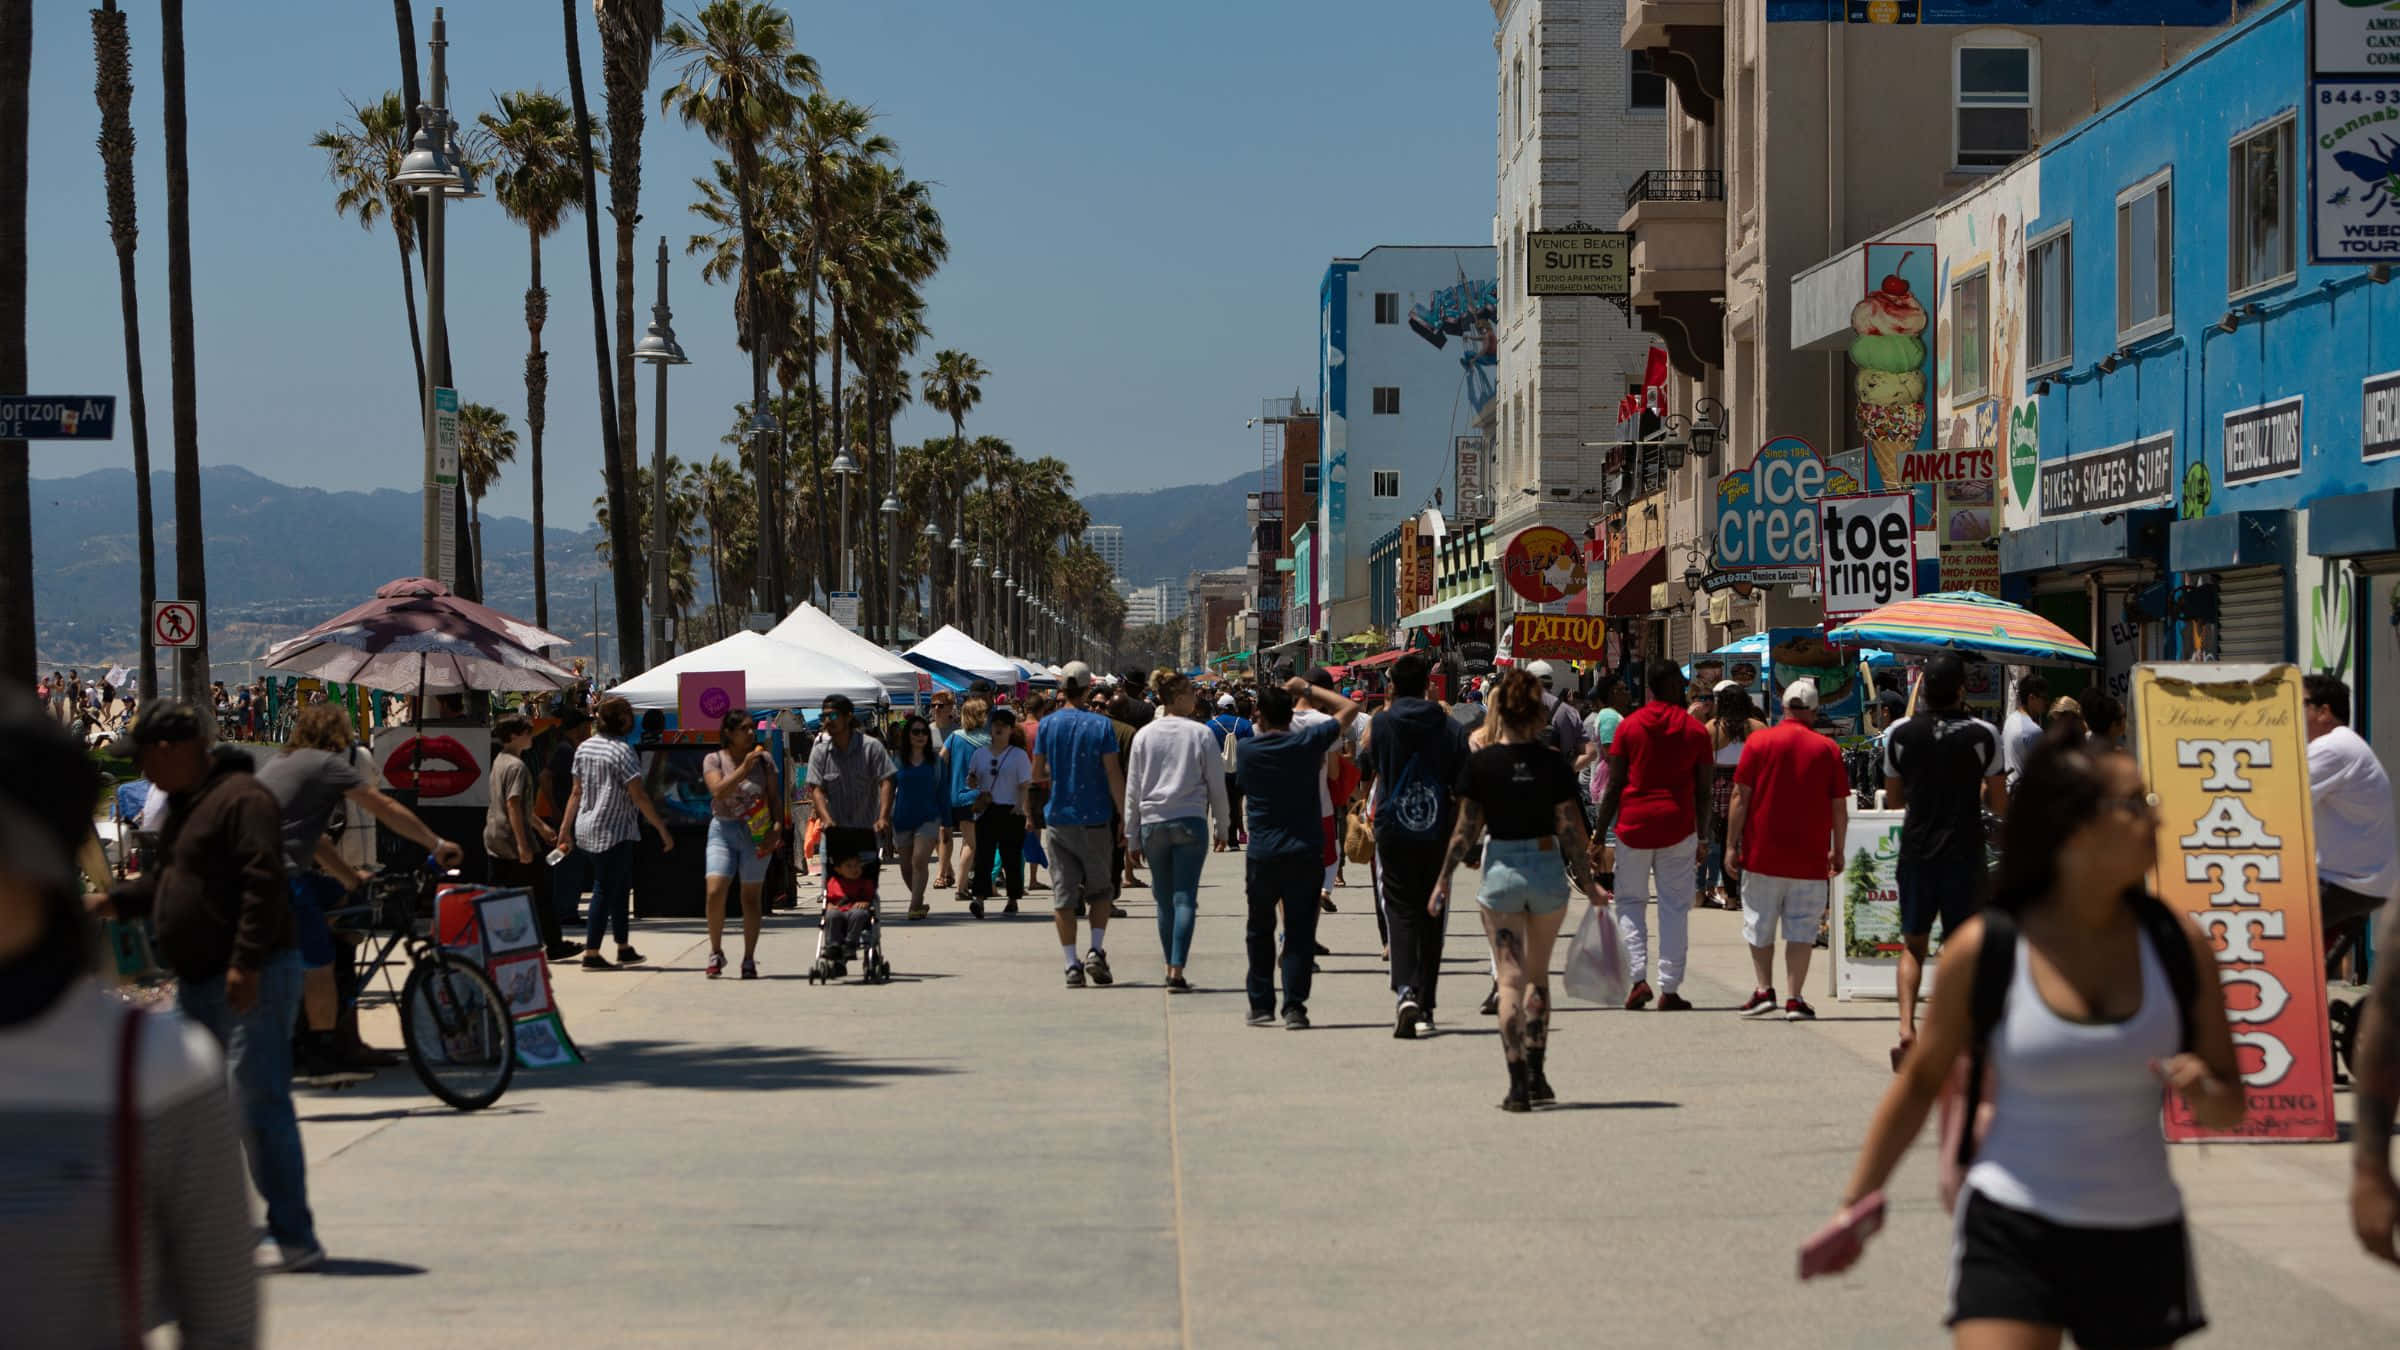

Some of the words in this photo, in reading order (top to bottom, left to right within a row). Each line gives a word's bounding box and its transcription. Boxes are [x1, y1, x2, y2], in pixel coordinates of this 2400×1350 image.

[1535, 274, 1566, 282] STUDIO
[1567, 274, 1623, 282] APARTMENTS
[1535, 283, 1582, 291] FURNISHED
[1584, 283, 1624, 291] MONTHLY
[0, 402, 66, 422] orizon
[81, 400, 106, 422] Av
[440, 417, 456, 431] FREE
[2225, 417, 2270, 472] WEEDBUZZ
[2271, 409, 2298, 465] TOURS
[1901, 449, 1994, 482] ANKLETS
[2043, 469, 2074, 510] BIKES
[2083, 457, 2126, 504] SKATES
[2136, 447, 2170, 494] SURF
[1824, 506, 1909, 562] toe
[1404, 528, 1415, 611] PIZZA
[1942, 555, 1962, 565] TOE
[1966, 553, 1998, 565] RINGS
[1778, 571, 1799, 581] Local
[1830, 560, 1911, 604] rings
[1941, 580, 1999, 592] ANKLETS
[1515, 615, 1606, 650] TATTOO
[2109, 669, 2130, 697] SC
[2157, 704, 2219, 728] House
[2223, 708, 2246, 730] of
[1868, 890, 1898, 901] DAB
